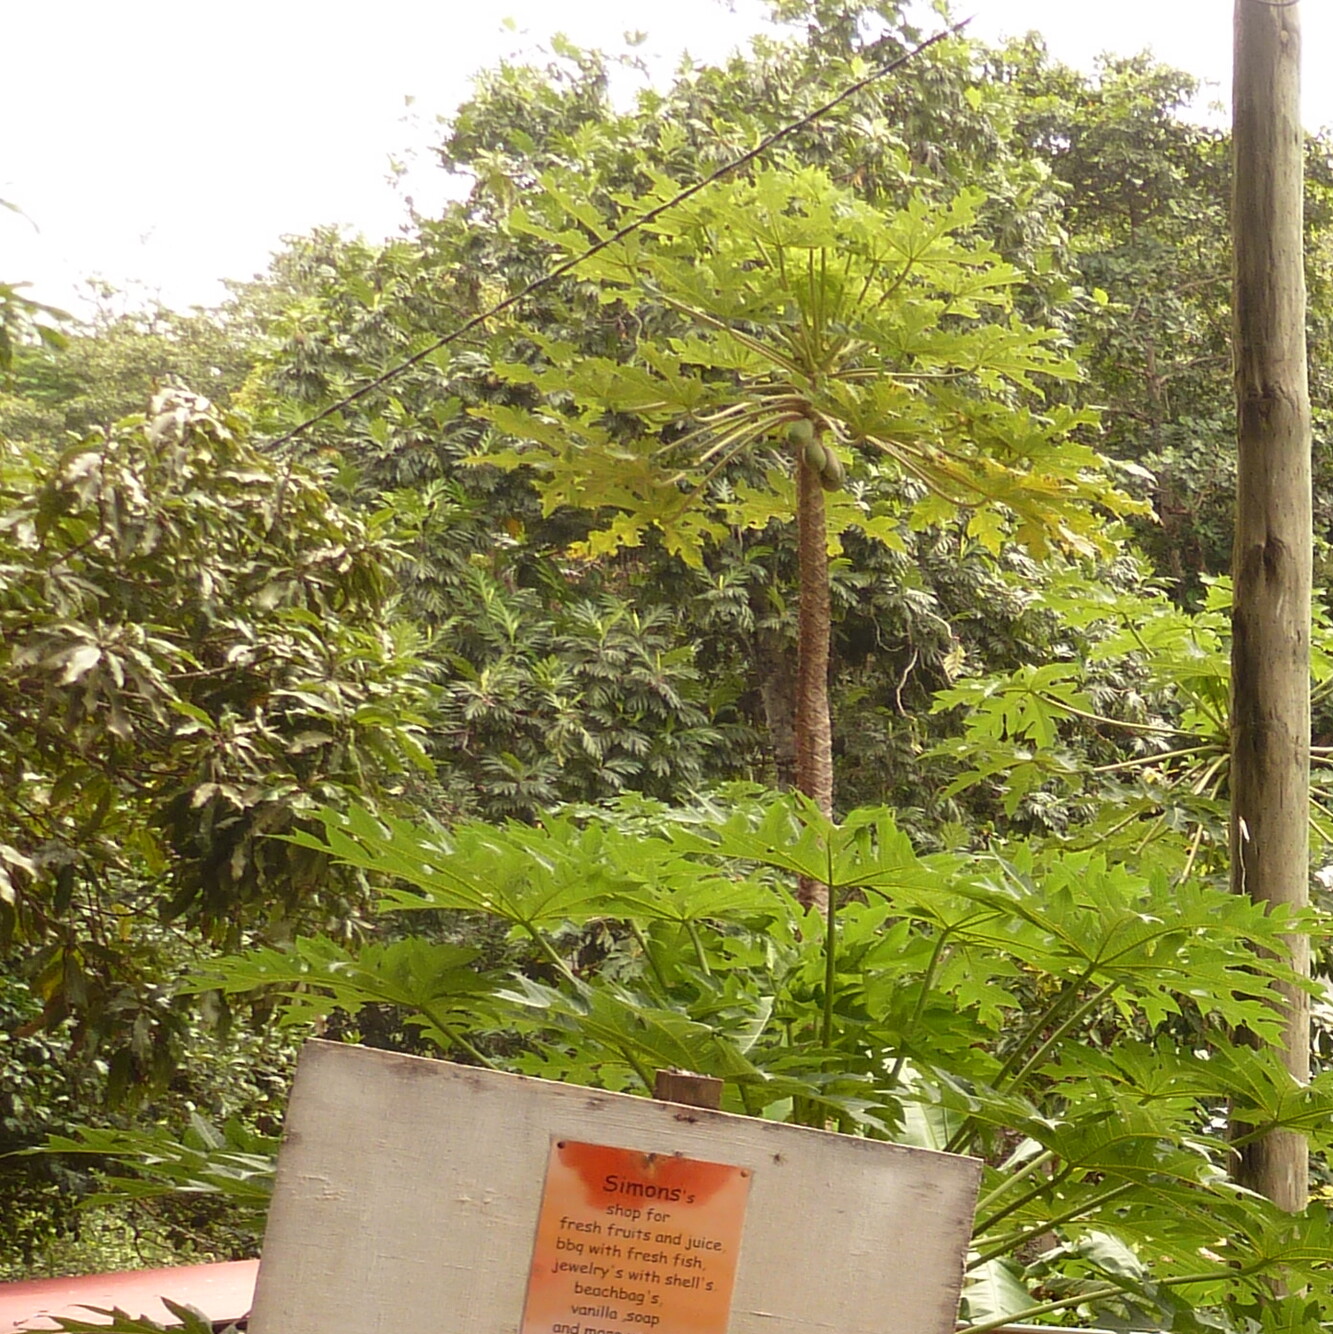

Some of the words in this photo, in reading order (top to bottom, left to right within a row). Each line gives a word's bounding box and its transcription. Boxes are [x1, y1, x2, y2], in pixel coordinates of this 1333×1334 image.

[602, 1175, 696, 1204] Simons's
[606, 1204, 641, 1221] shop
[646, 1208, 671, 1222] for
[559, 1216, 602, 1234] fresh
[607, 1224, 651, 1241] fruits
[655, 1232, 681, 1246] and
[684, 1237, 727, 1253] juice,
[556, 1237, 584, 1255] bbq
[589, 1243, 622, 1257] with
[627, 1248, 668, 1264] fresh
[552, 1259, 624, 1279] jewelry's
[628, 1270, 661, 1284] with
[571, 1303, 618, 1319] vanilla
